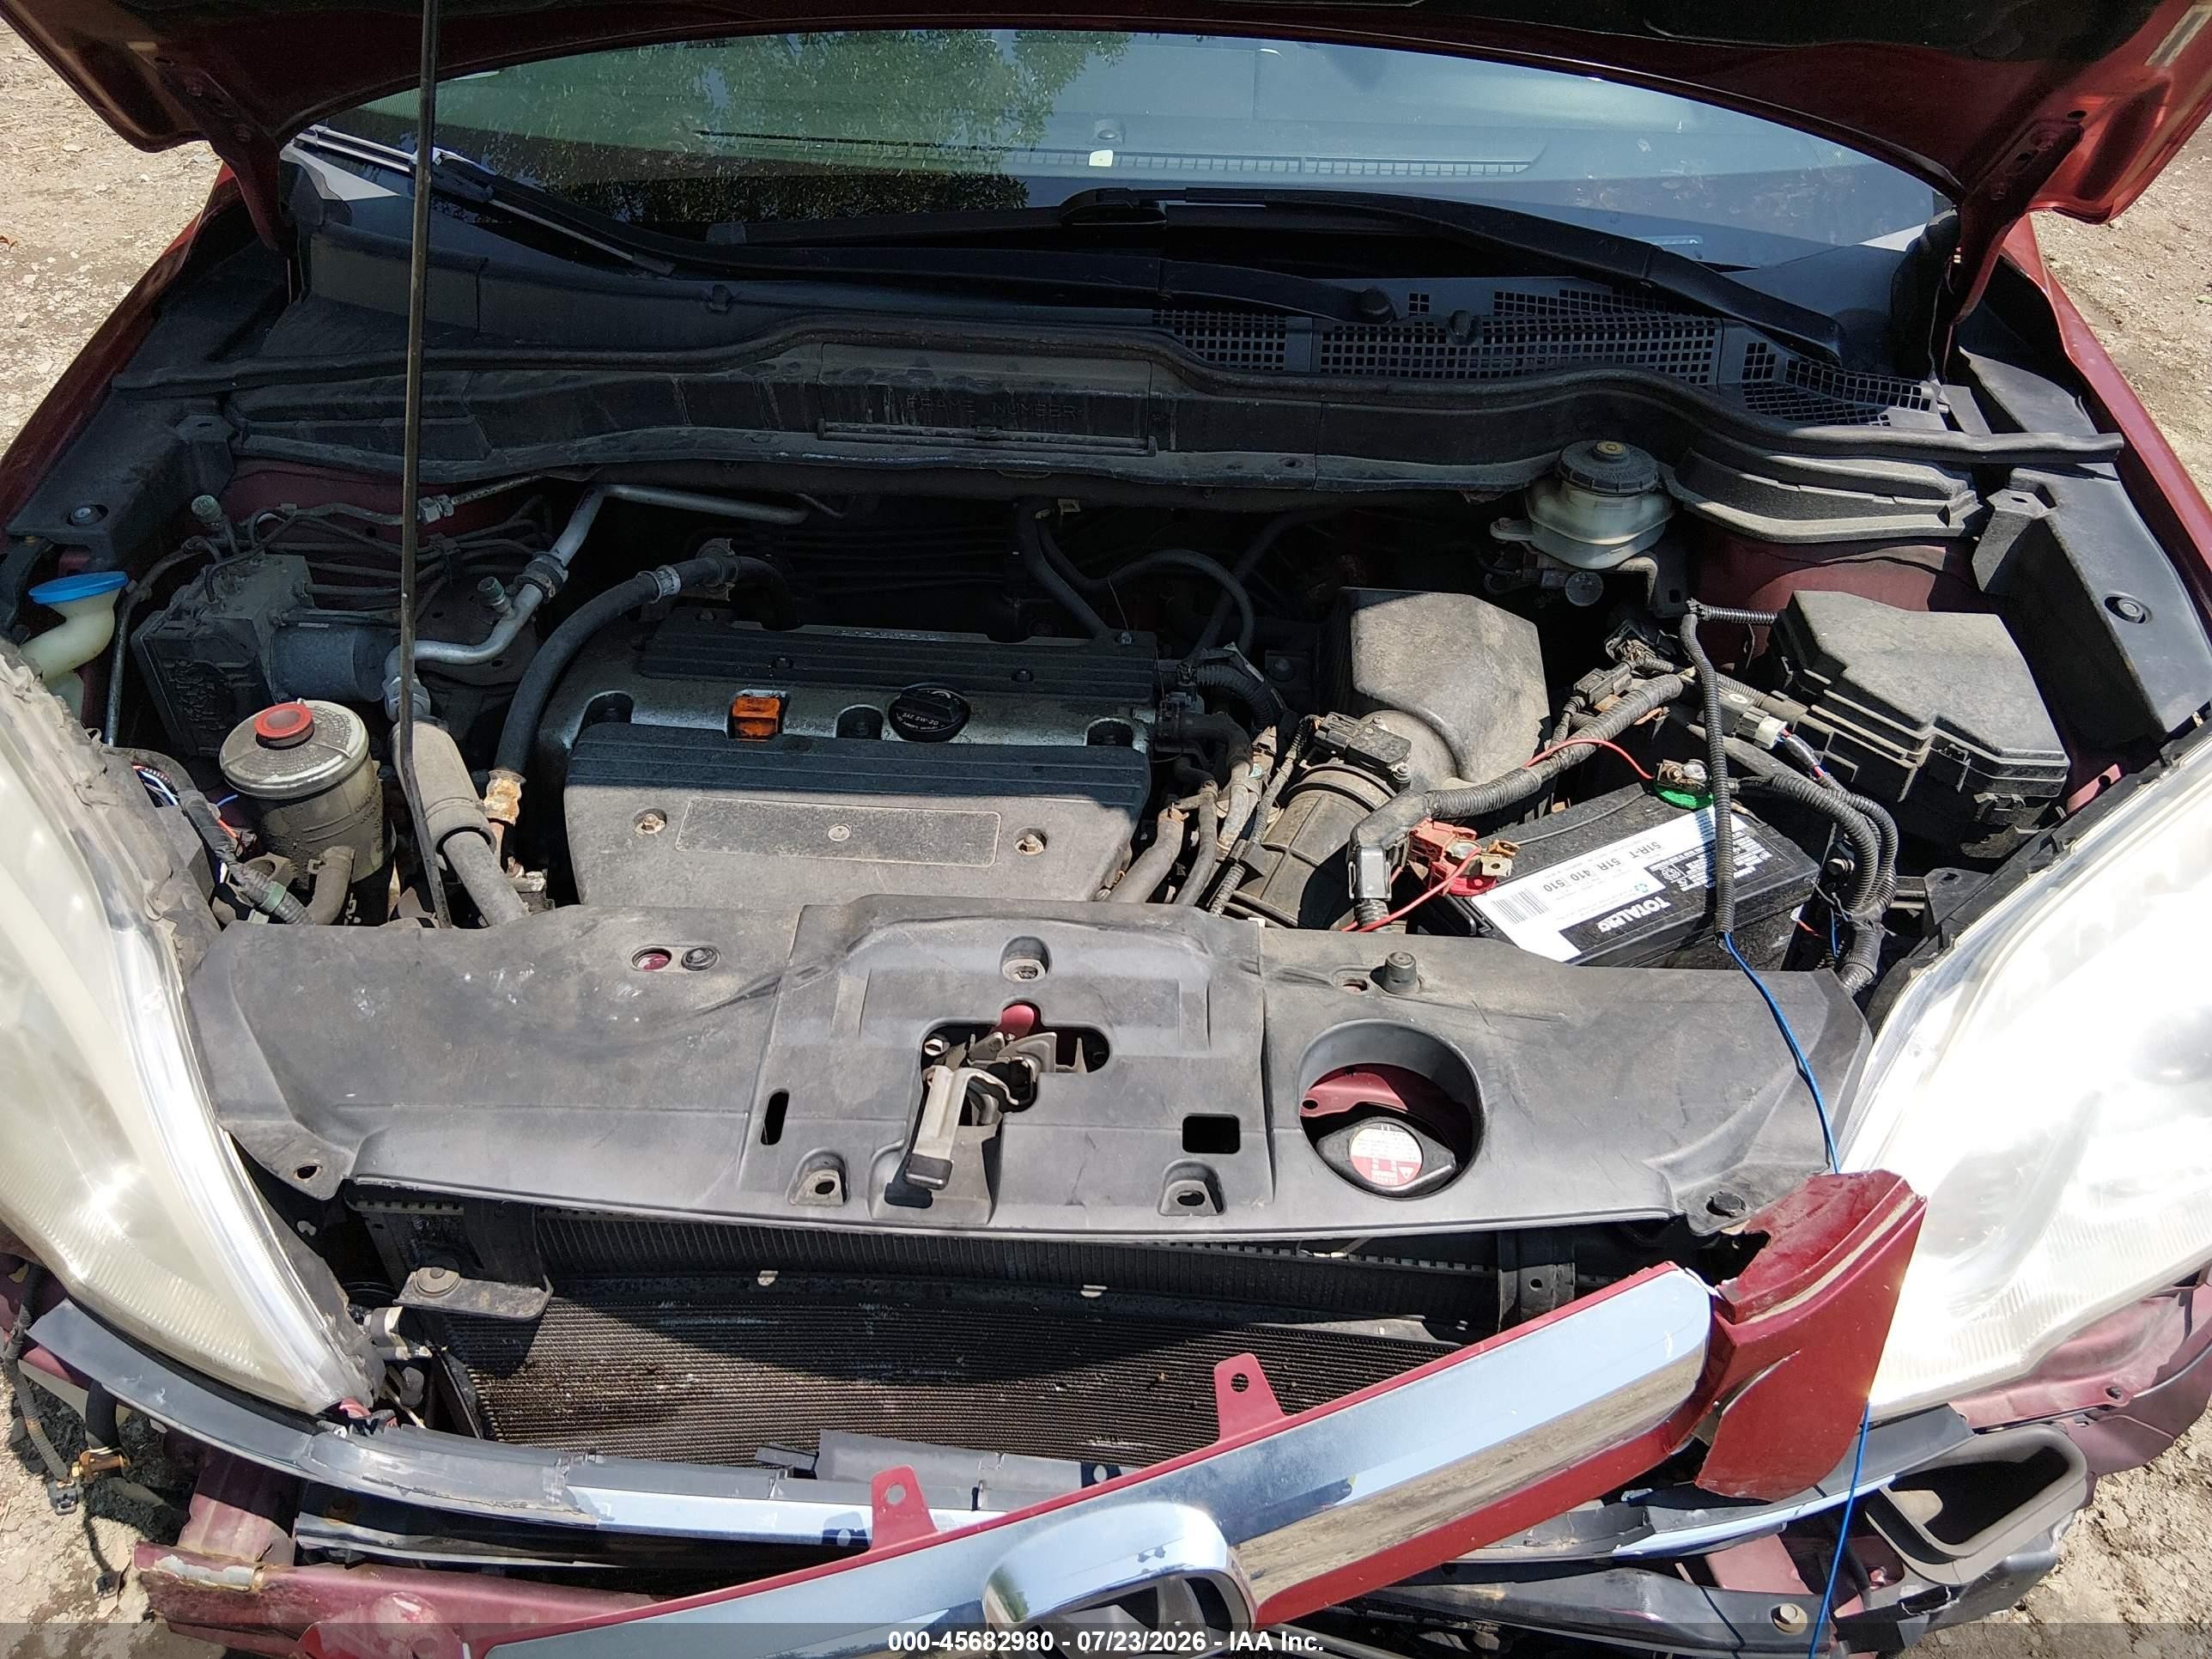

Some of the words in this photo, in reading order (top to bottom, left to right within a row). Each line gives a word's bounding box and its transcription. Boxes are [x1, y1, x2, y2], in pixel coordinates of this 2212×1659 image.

[992, 401, 1079, 420] NUMBER
[1629, 842, 1662, 860] 51R-T
[1595, 857, 1622, 872] 51R
[1570, 869, 1591, 882] 410
[1543, 878, 1565, 892] 510
